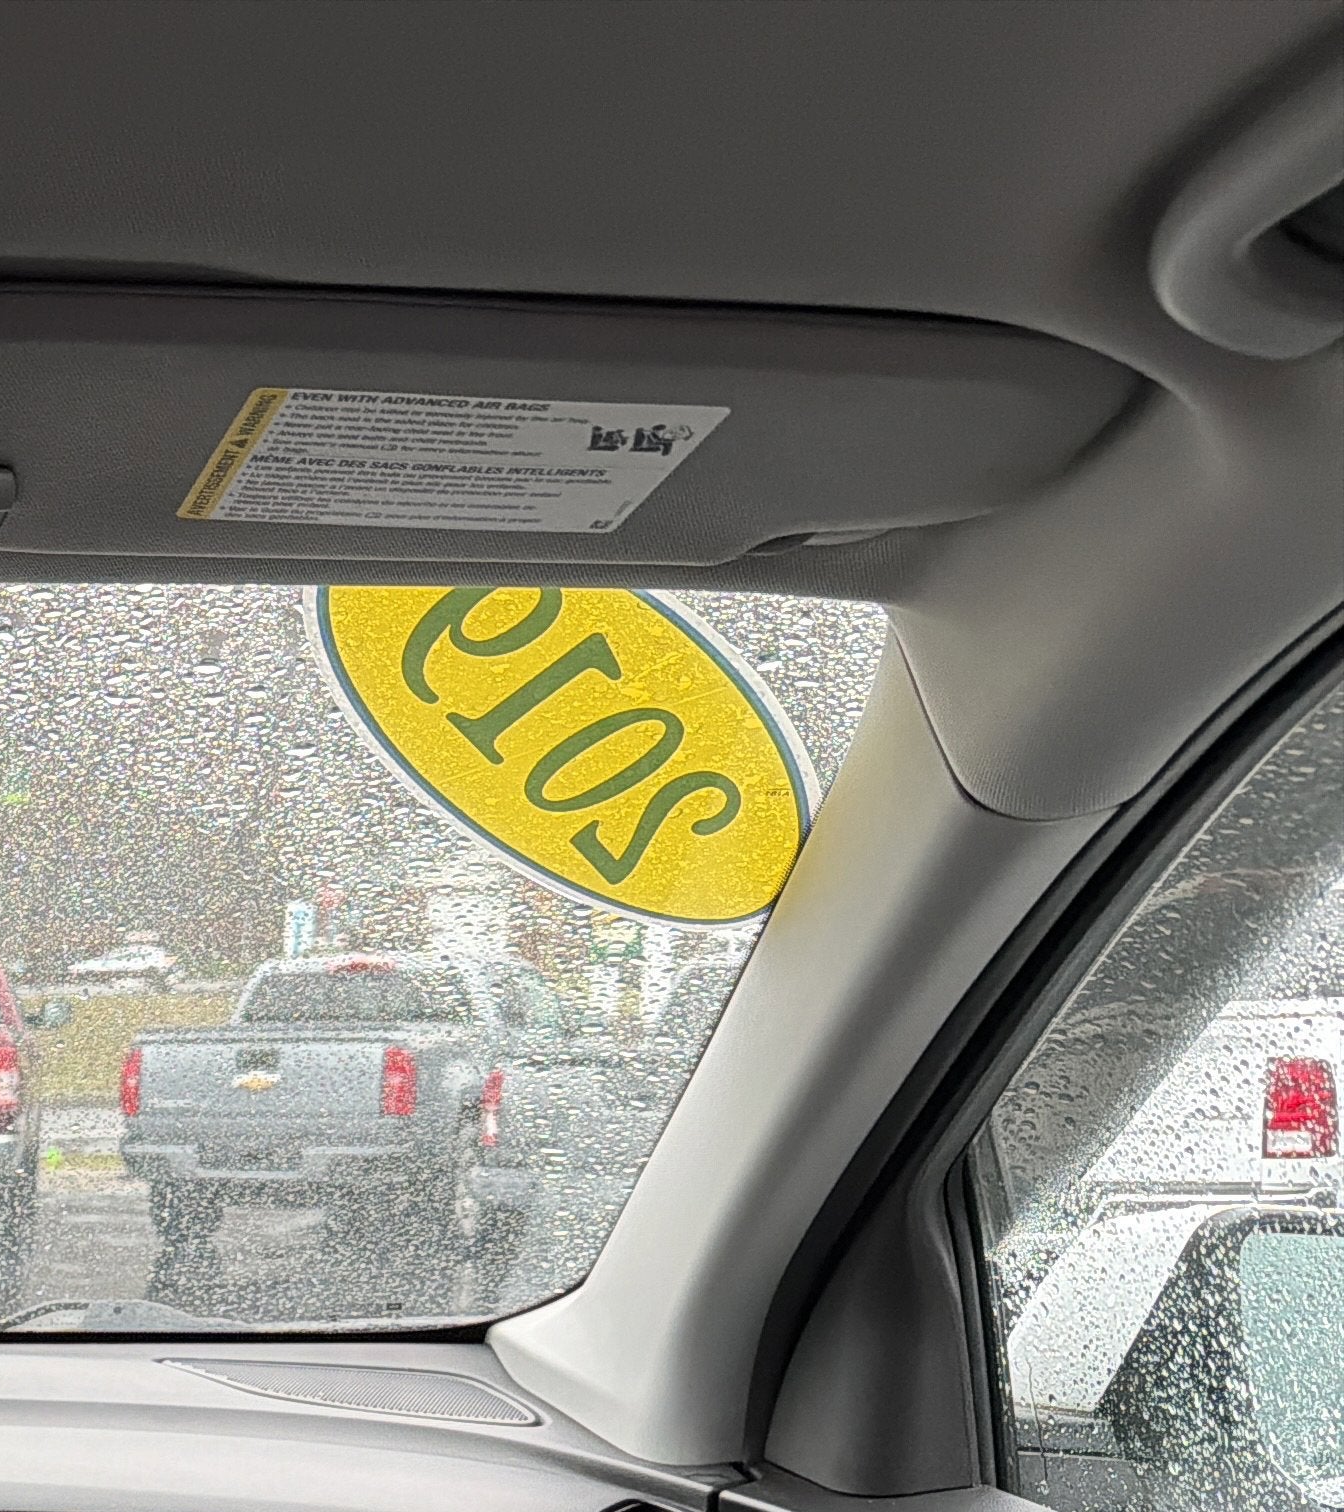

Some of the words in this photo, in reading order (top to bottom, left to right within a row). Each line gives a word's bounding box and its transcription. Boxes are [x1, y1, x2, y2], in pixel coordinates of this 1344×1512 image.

[292, 392, 333, 402] EVEN
[337, 394, 380, 403] WITH
[380, 396, 469, 408] ADVANCED
[472, 401, 502, 410] AIR
[504, 402, 551, 411] BAGS
[187, 449, 240, 516] AVERTISSEMENT
[238, 393, 278, 436] WARNING
[249, 454, 296, 465] MÊME
[297, 457, 336, 466] AVEC
[337, 459, 366, 468] DES
[368, 462, 409, 470] SACS
[412, 463, 505, 475] GONFLABLES
[506, 467, 608, 478] INTELLIGENTS
